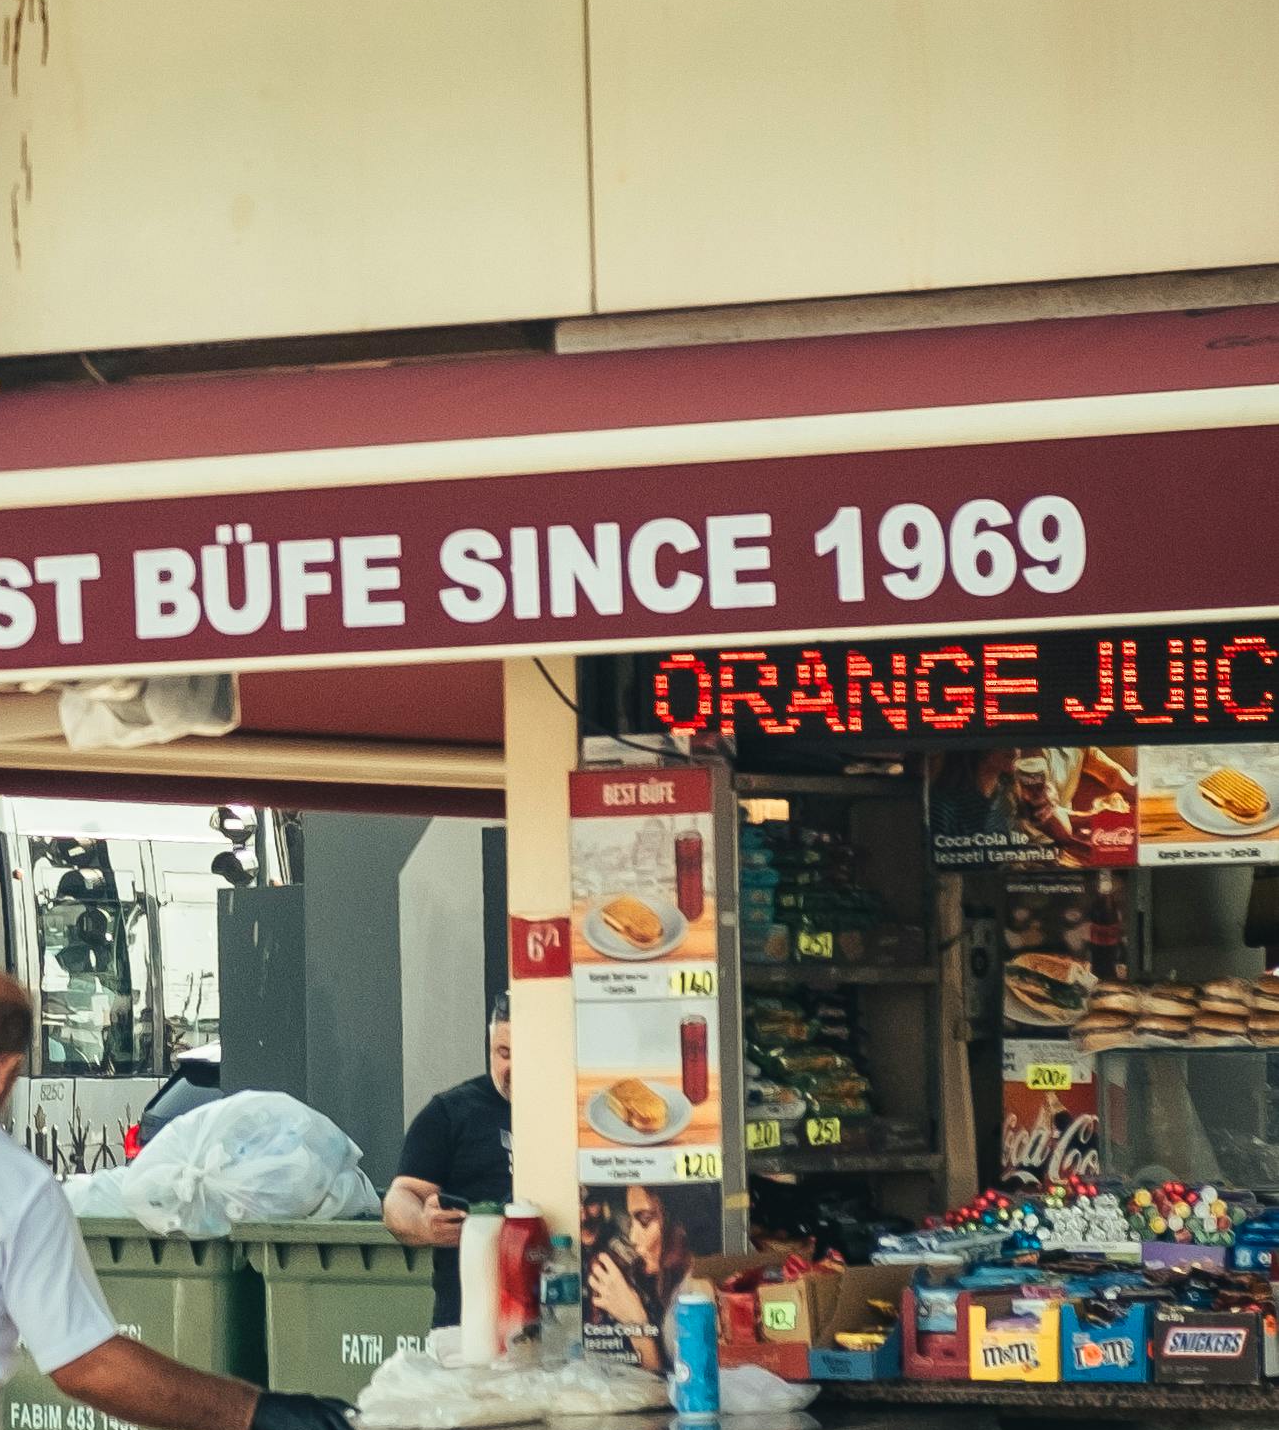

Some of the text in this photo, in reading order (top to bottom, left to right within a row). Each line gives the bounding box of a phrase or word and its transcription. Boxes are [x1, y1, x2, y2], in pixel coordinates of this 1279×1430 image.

[133, 523, 405, 641] BÜFE
[438, 512, 777, 624] SINCE
[814, 494, 1087, 603] 1969
[653, 636, 1279, 738] ORANGE JUIC
[602, 781, 637, 807] BEST
[1169, 1332, 1243, 1354] SNICKERS
